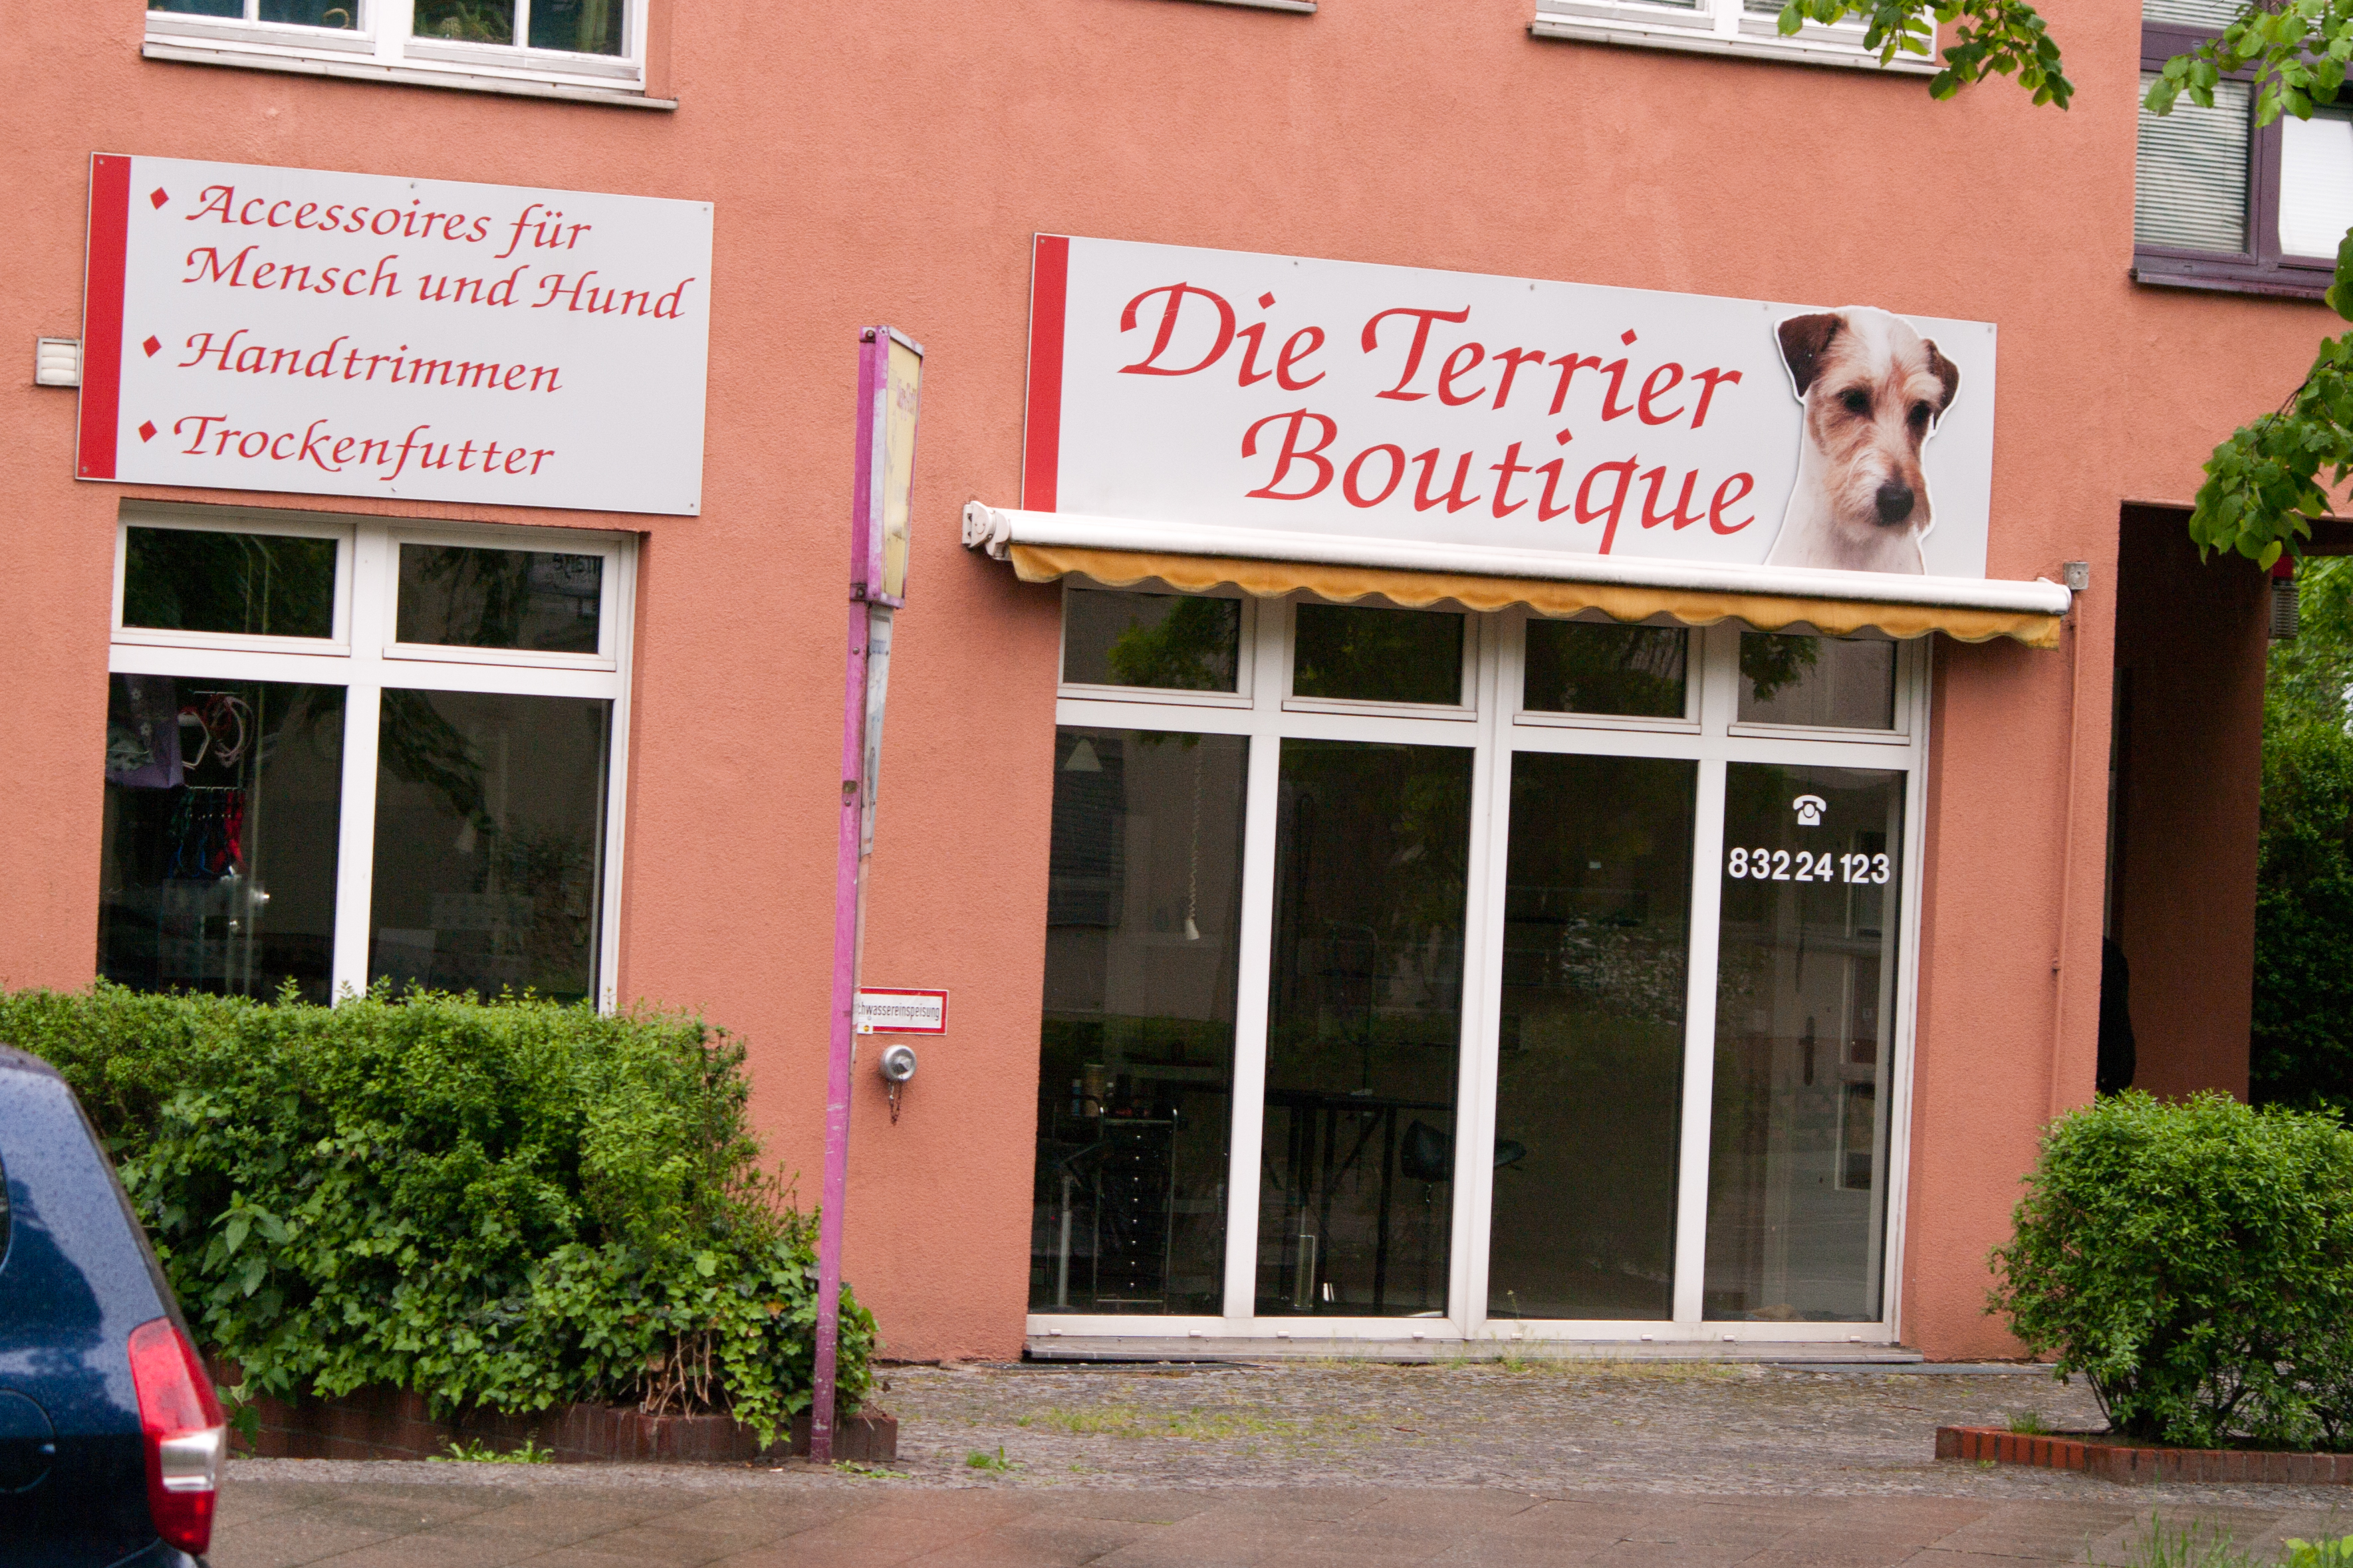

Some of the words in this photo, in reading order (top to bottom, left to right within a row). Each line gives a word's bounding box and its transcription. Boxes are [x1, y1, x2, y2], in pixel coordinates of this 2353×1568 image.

[186, 185, 491, 243] Accessoires
[494, 203, 592, 259] für
[182, 245, 401, 298] Mensch
[418, 265, 530, 307] und
[531, 271, 695, 320] Hund
[178, 328, 561, 393] Handtrimmen
[1118, 281, 1326, 392] Die
[1360, 305, 1743, 429] Terrier
[174, 415, 555, 481] Trockenfutter
[1241, 407, 1755, 556] Boutique
[857, 1002, 940, 1021] chwassereinspeisung
